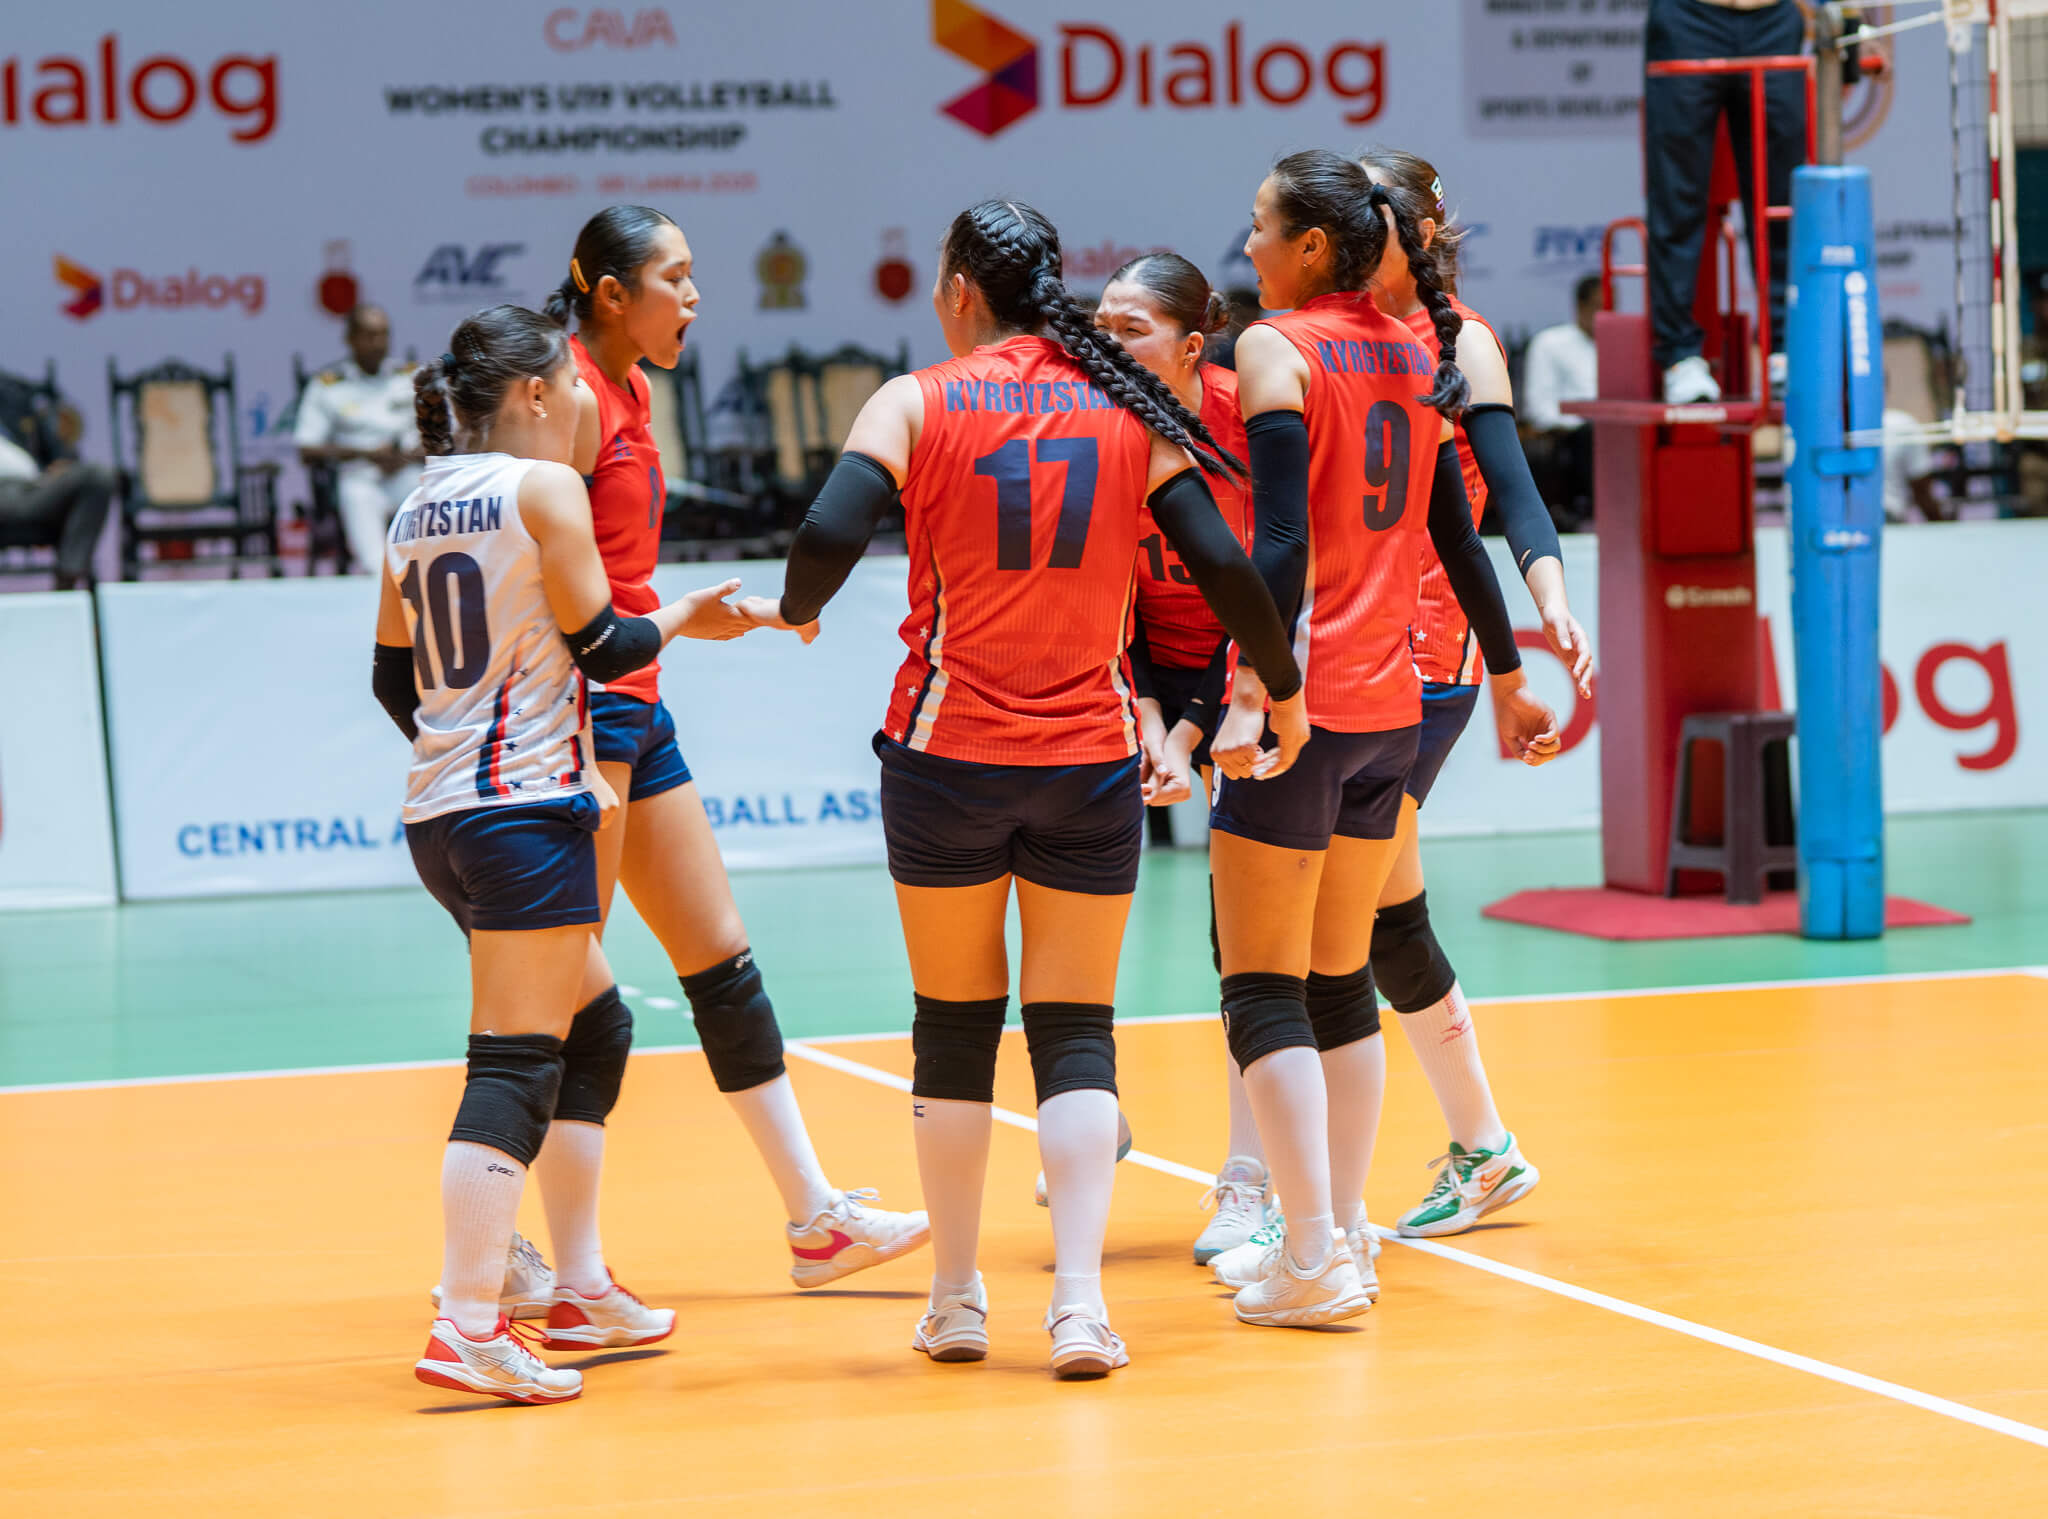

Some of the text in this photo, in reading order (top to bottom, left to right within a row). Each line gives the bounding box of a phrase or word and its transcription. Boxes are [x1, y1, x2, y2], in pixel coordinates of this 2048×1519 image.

[543, 9, 676, 51] CAVA
[1057, 20, 1388, 127] Dialog
[623, 80, 836, 111] VOLLEYBALL
[480, 124, 748, 157] CHAMPIONSHIP
[112, 269, 265, 316] Dialog
[946, 380, 1126, 414] KYRGYZSTA
[1362, 400, 1410, 531] 9
[974, 437, 1099, 571] 17
[400, 551, 491, 690] 10
[818, 789, 881, 823] AS
[178, 818, 379, 857] CENTRAL
